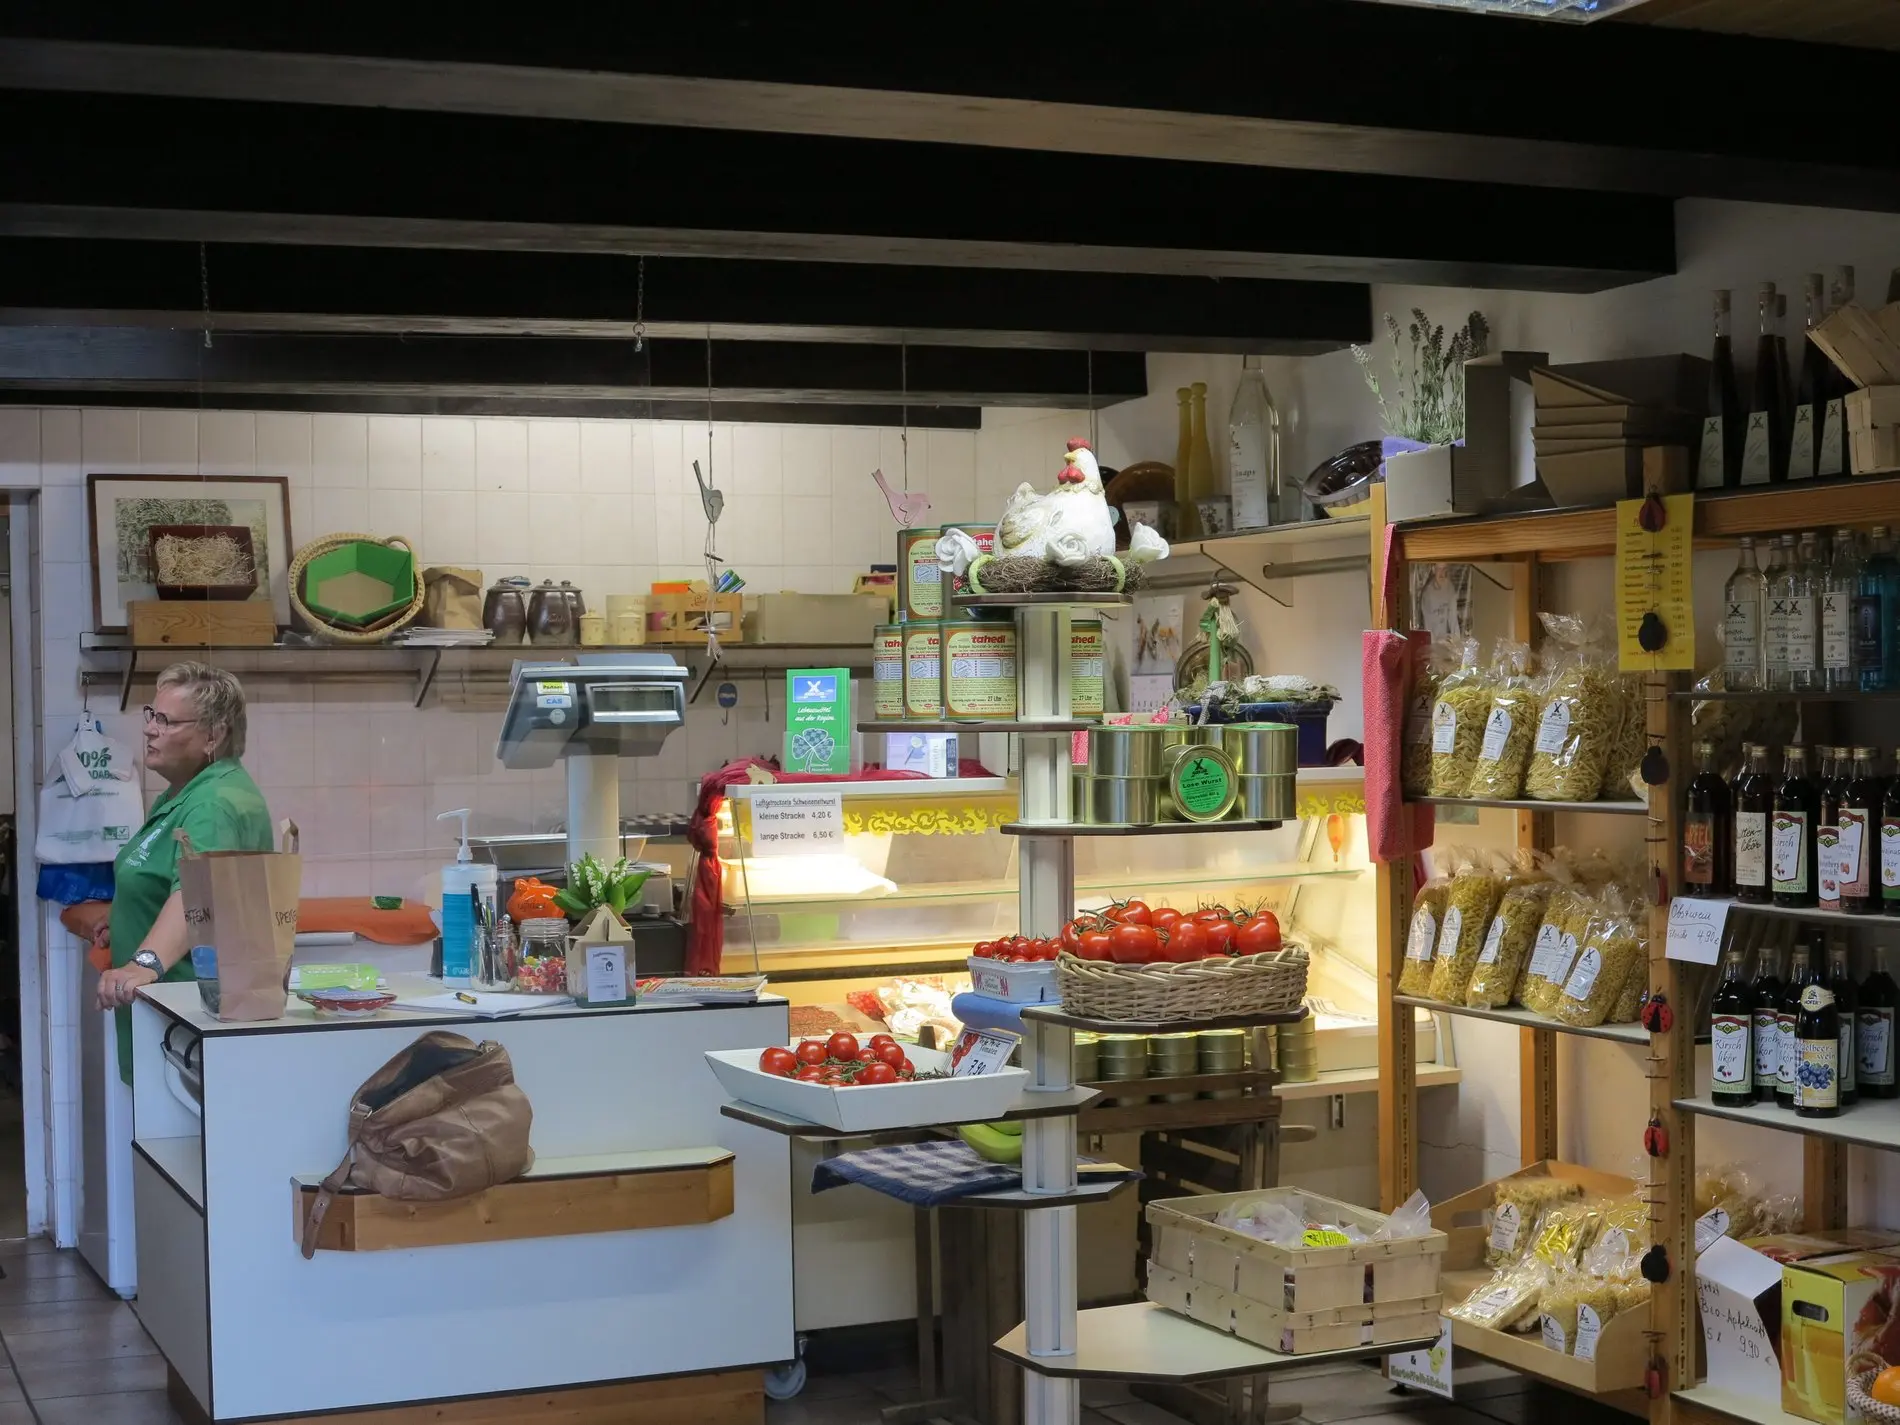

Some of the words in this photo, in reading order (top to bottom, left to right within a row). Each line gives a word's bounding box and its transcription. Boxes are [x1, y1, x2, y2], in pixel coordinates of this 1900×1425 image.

[927, 637, 940, 645] ta
[546, 695, 563, 705] CAS
[1182, 781, 1200, 789] Lose
[1200, 777, 1222, 786] Wurst
[759, 812, 779, 821] kleine
[779, 812, 806, 820] Stracke
[811, 811, 826, 820] 4,20
[827, 811, 832, 819] €
[760, 832, 779, 842] lange
[779, 832, 806, 840] Stracke
[813, 831, 827, 840] 6,50
[1671, 904, 1712, 921] Obstwein
[1714, 1038, 1742, 1050] Kirsch
[1706, 1327, 1713, 1341] 5
[1410, 1355, 1417, 1365] &
